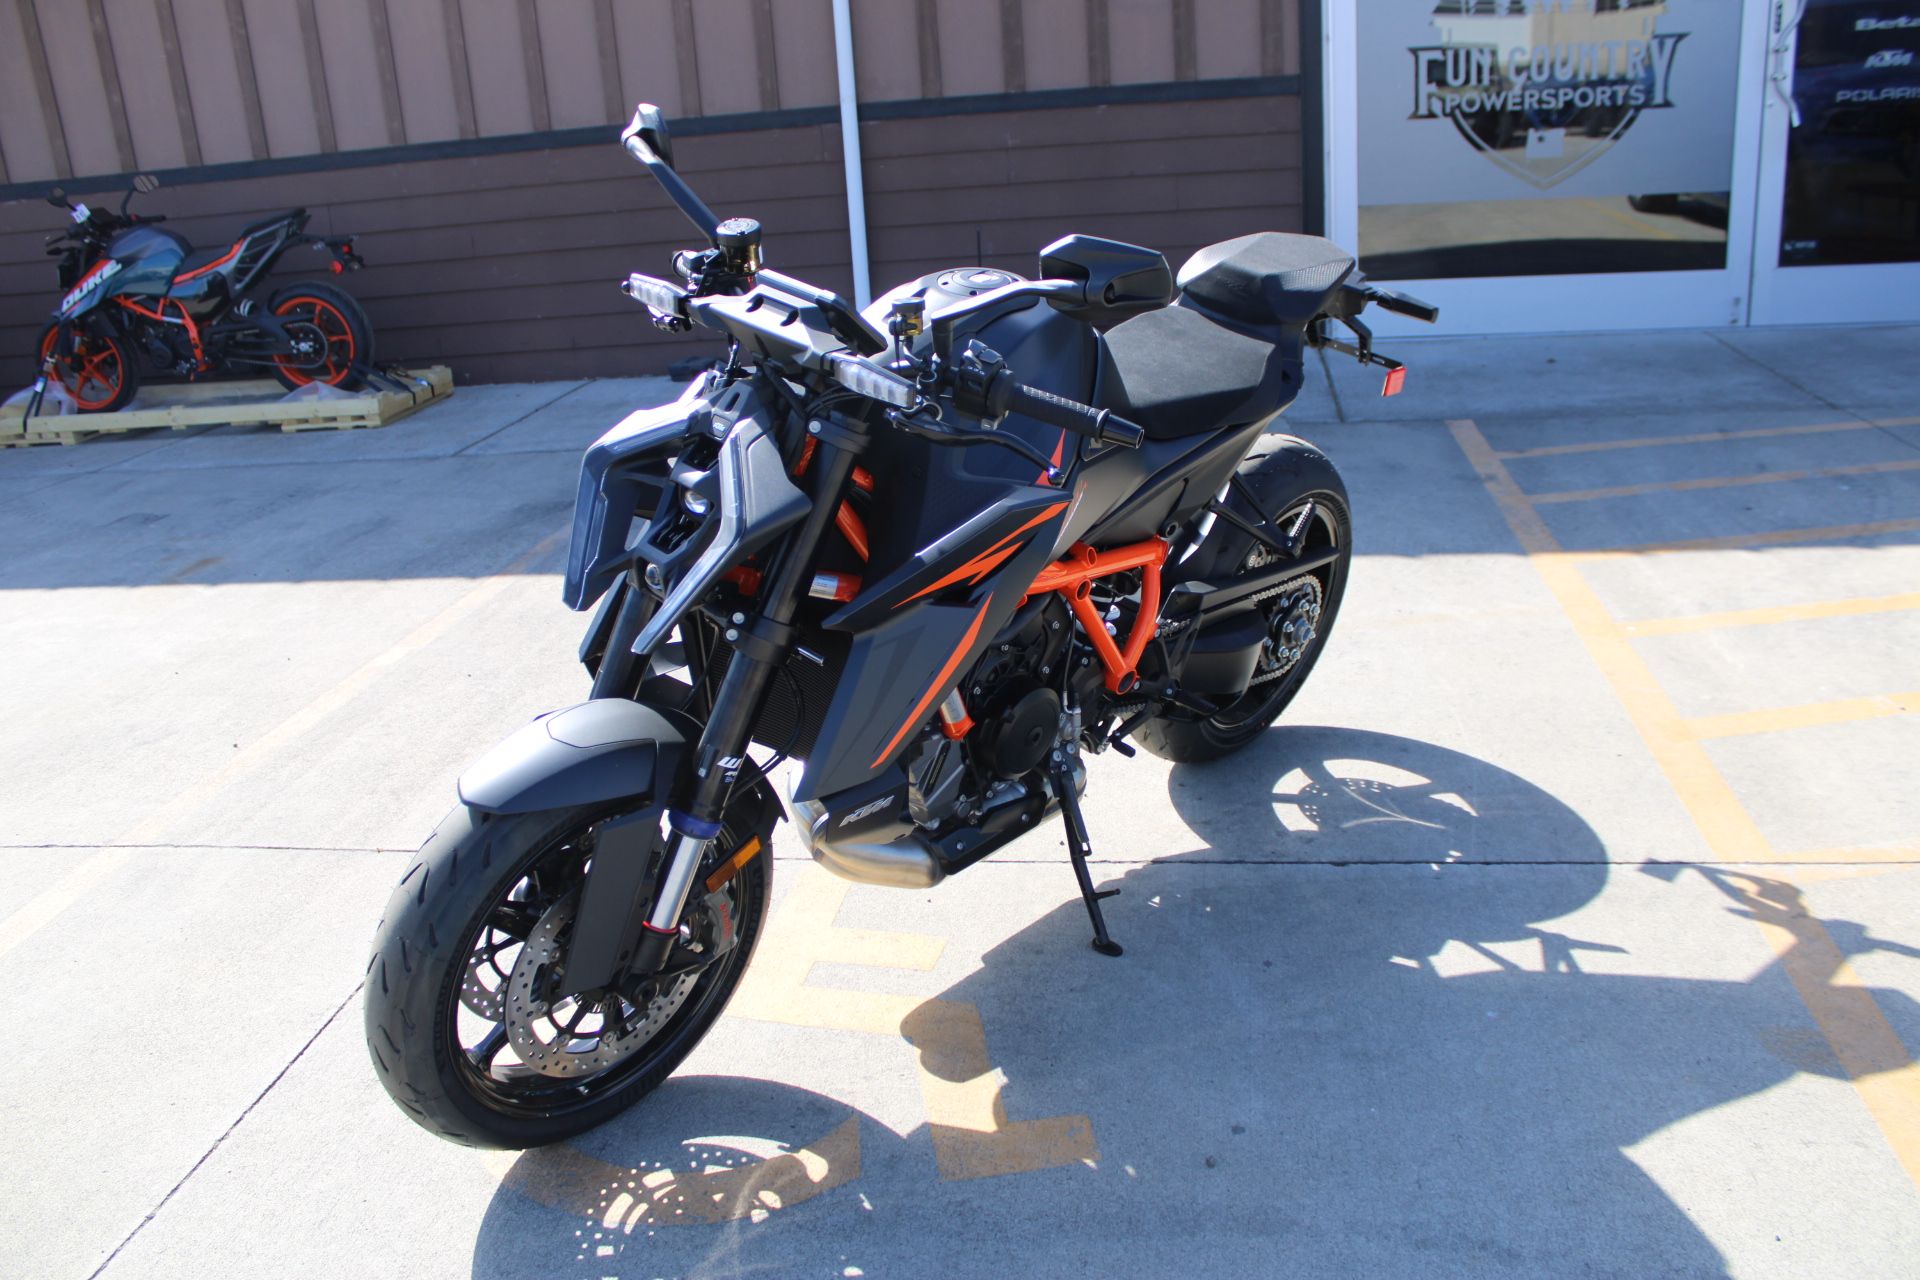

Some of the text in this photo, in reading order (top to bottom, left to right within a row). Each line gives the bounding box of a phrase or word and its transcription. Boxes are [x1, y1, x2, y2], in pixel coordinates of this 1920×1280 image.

[1864, 49, 1914, 68] KTM
[1408, 32, 1691, 119] FUN COUNTRY
[1446, 84, 1645, 113] POWERSPORTS
[61, 259, 122, 313] DUKE
[838, 795, 895, 828] KTM
